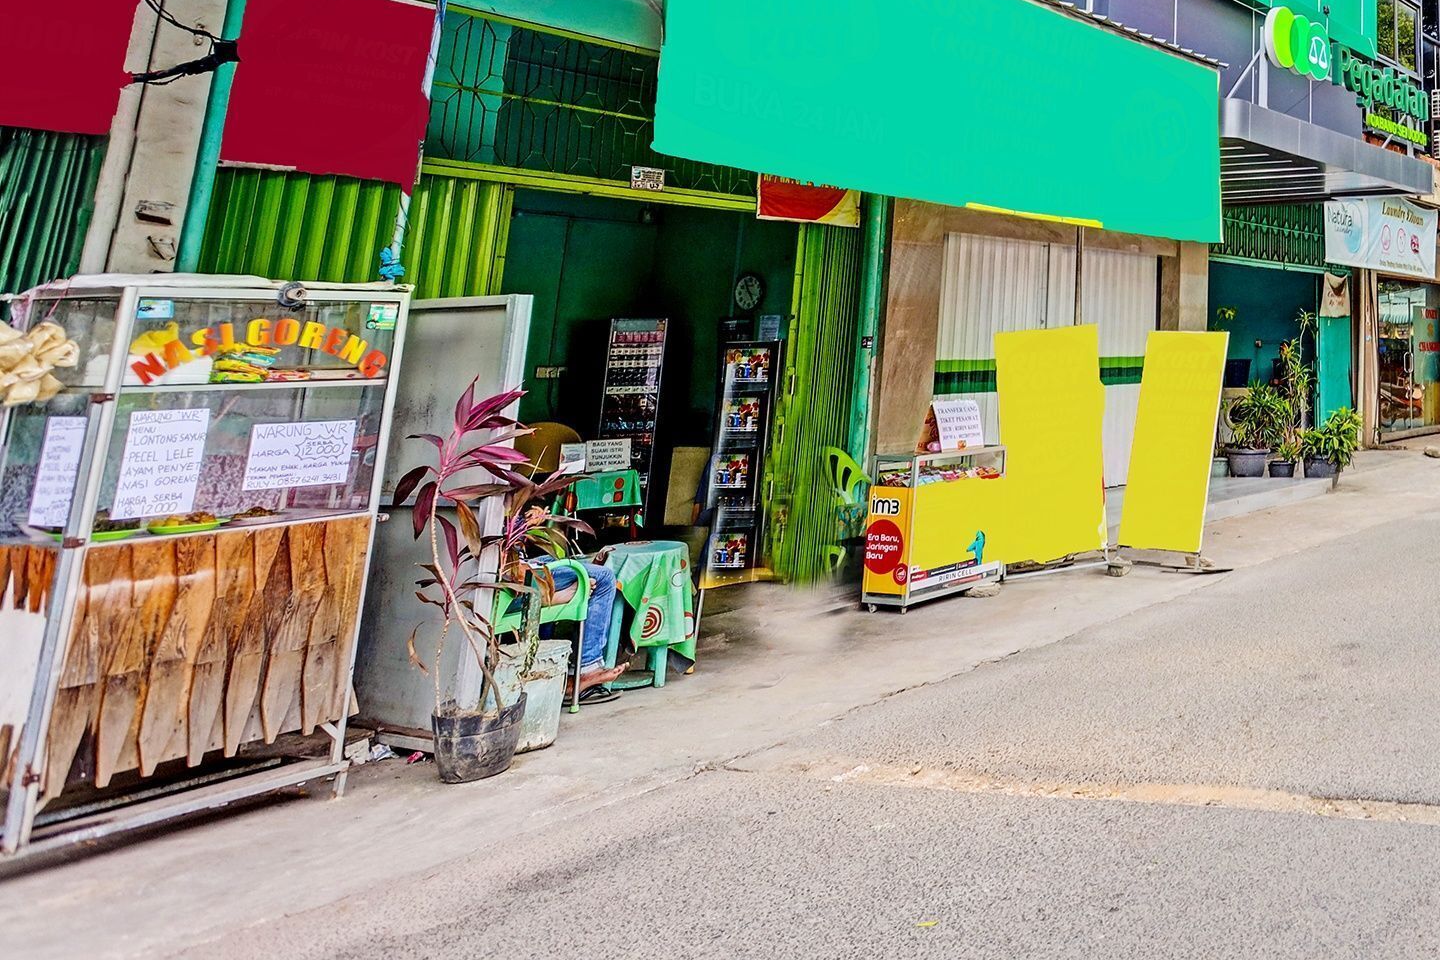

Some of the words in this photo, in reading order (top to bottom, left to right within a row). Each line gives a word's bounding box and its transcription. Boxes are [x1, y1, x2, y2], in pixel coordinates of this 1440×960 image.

[1332, 43, 1428, 121] Pegadaian
[1327, 205, 1352, 227] Natura
[131, 322, 235, 385] NASI
[247, 318, 387, 378] GORENG
[256, 424, 312, 439] WARUNG
[167, 448, 194, 461] LELE
[158, 461, 202, 473] PENYET
[154, 473, 198, 486] GORENG
[152, 492, 183, 503] SERBA
[871, 494, 900, 516] im3
[867, 533, 880, 541] Era
[880, 534, 900, 543] Baru,
[866, 542, 898, 553] Jaringan
[866, 551, 883, 560] Baru
[957, 569, 972, 577] CELL
